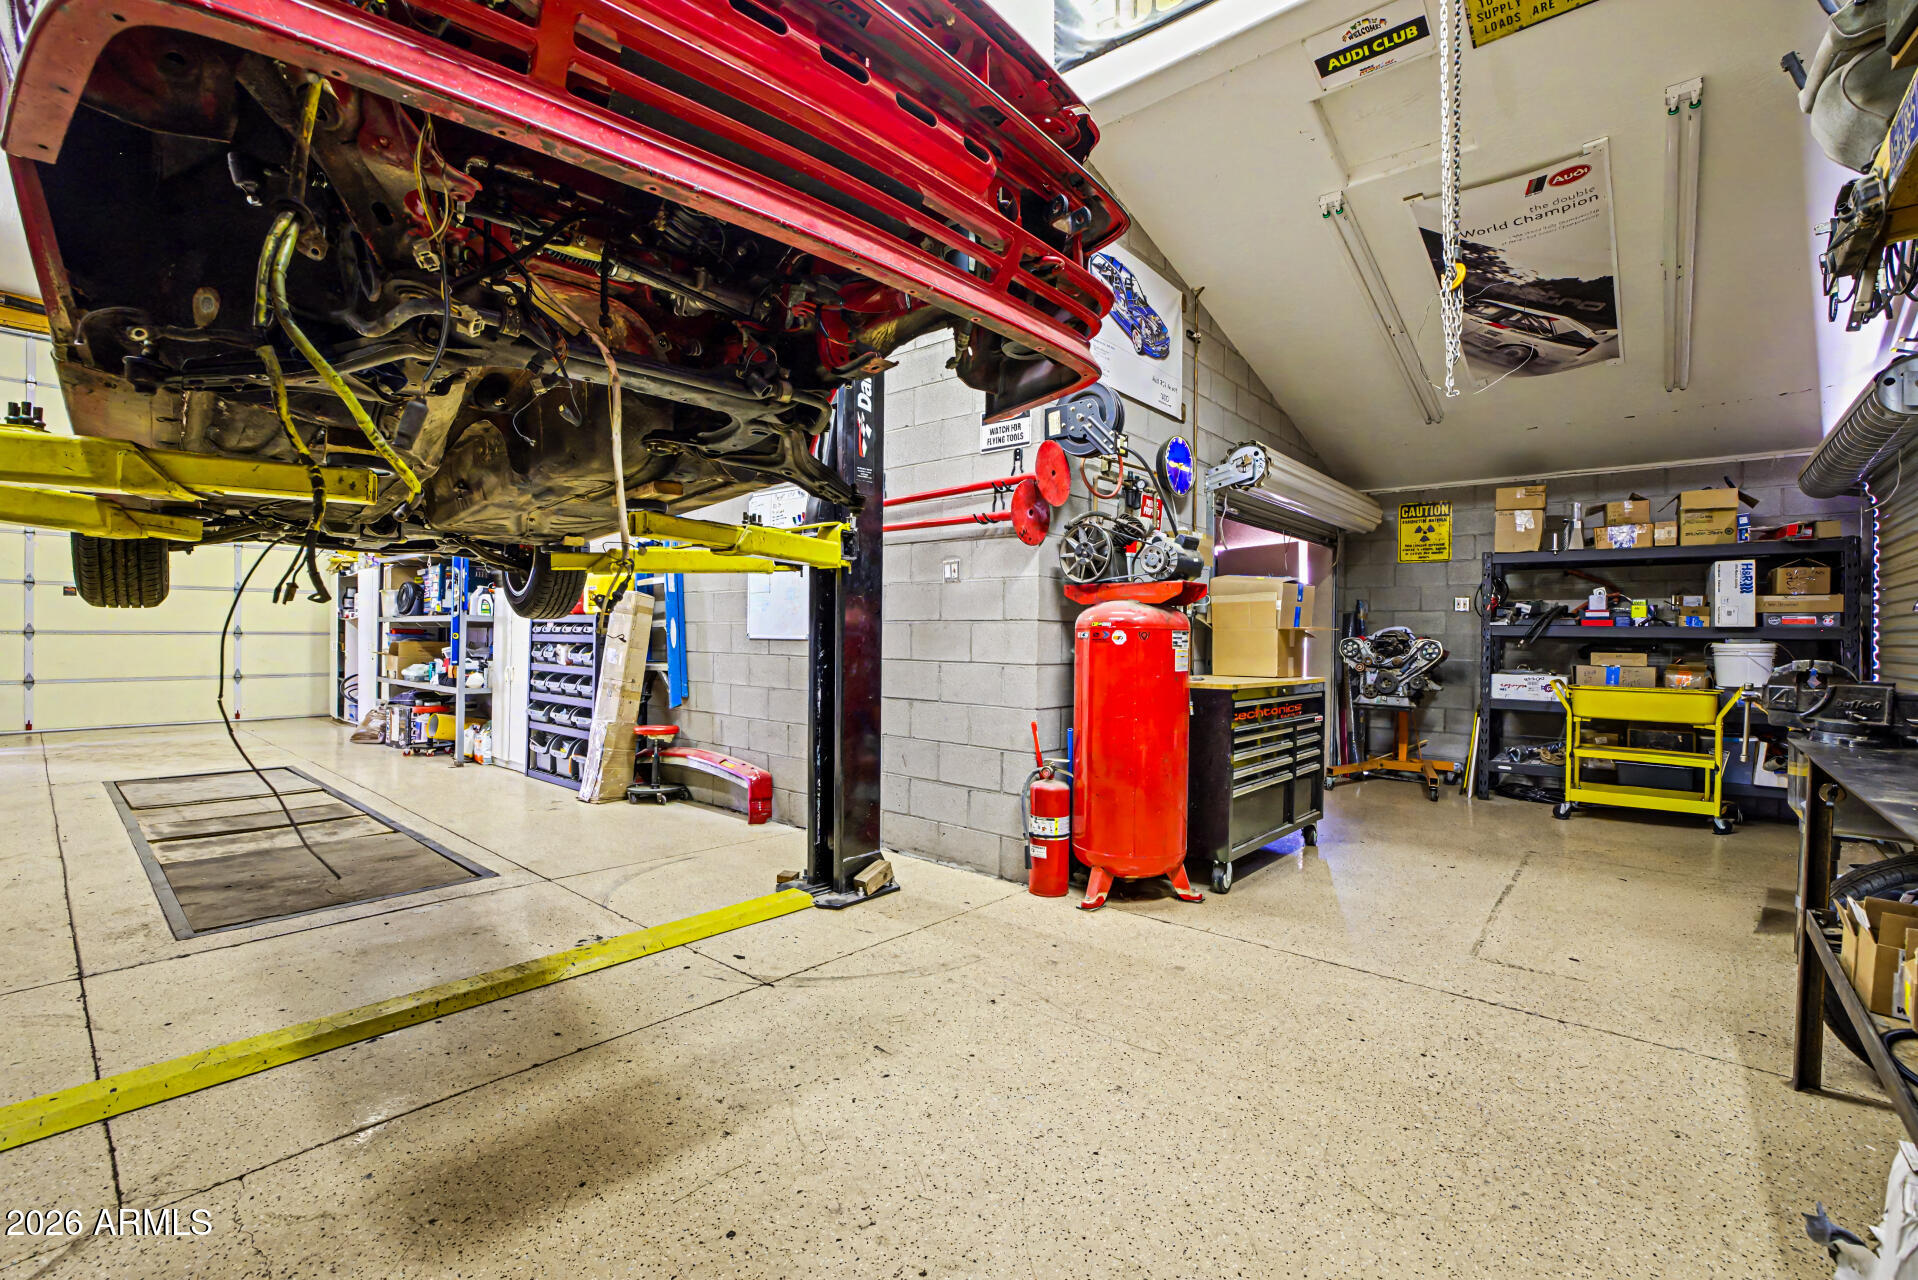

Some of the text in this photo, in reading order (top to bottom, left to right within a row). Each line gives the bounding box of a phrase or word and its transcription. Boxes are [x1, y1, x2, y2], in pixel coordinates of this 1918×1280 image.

[1477, 0, 1521, 23] SUPPLY
[1484, 0, 1555, 34] LOADS ARE
[1328, 45, 1370, 71] AUDI
[1372, 25, 1419, 52] CLUB
[1552, 167, 1589, 185] Audi
[1529, 203, 1549, 213] the
[1552, 186, 1596, 206] double
[1459, 220, 1508, 239] World
[1513, 194, 1599, 227] Champion
[987, 432, 1024, 446] FLYING TOOLS
[989, 422, 1022, 436] WATCH FOR
[1402, 504, 1449, 518] CAUTION
